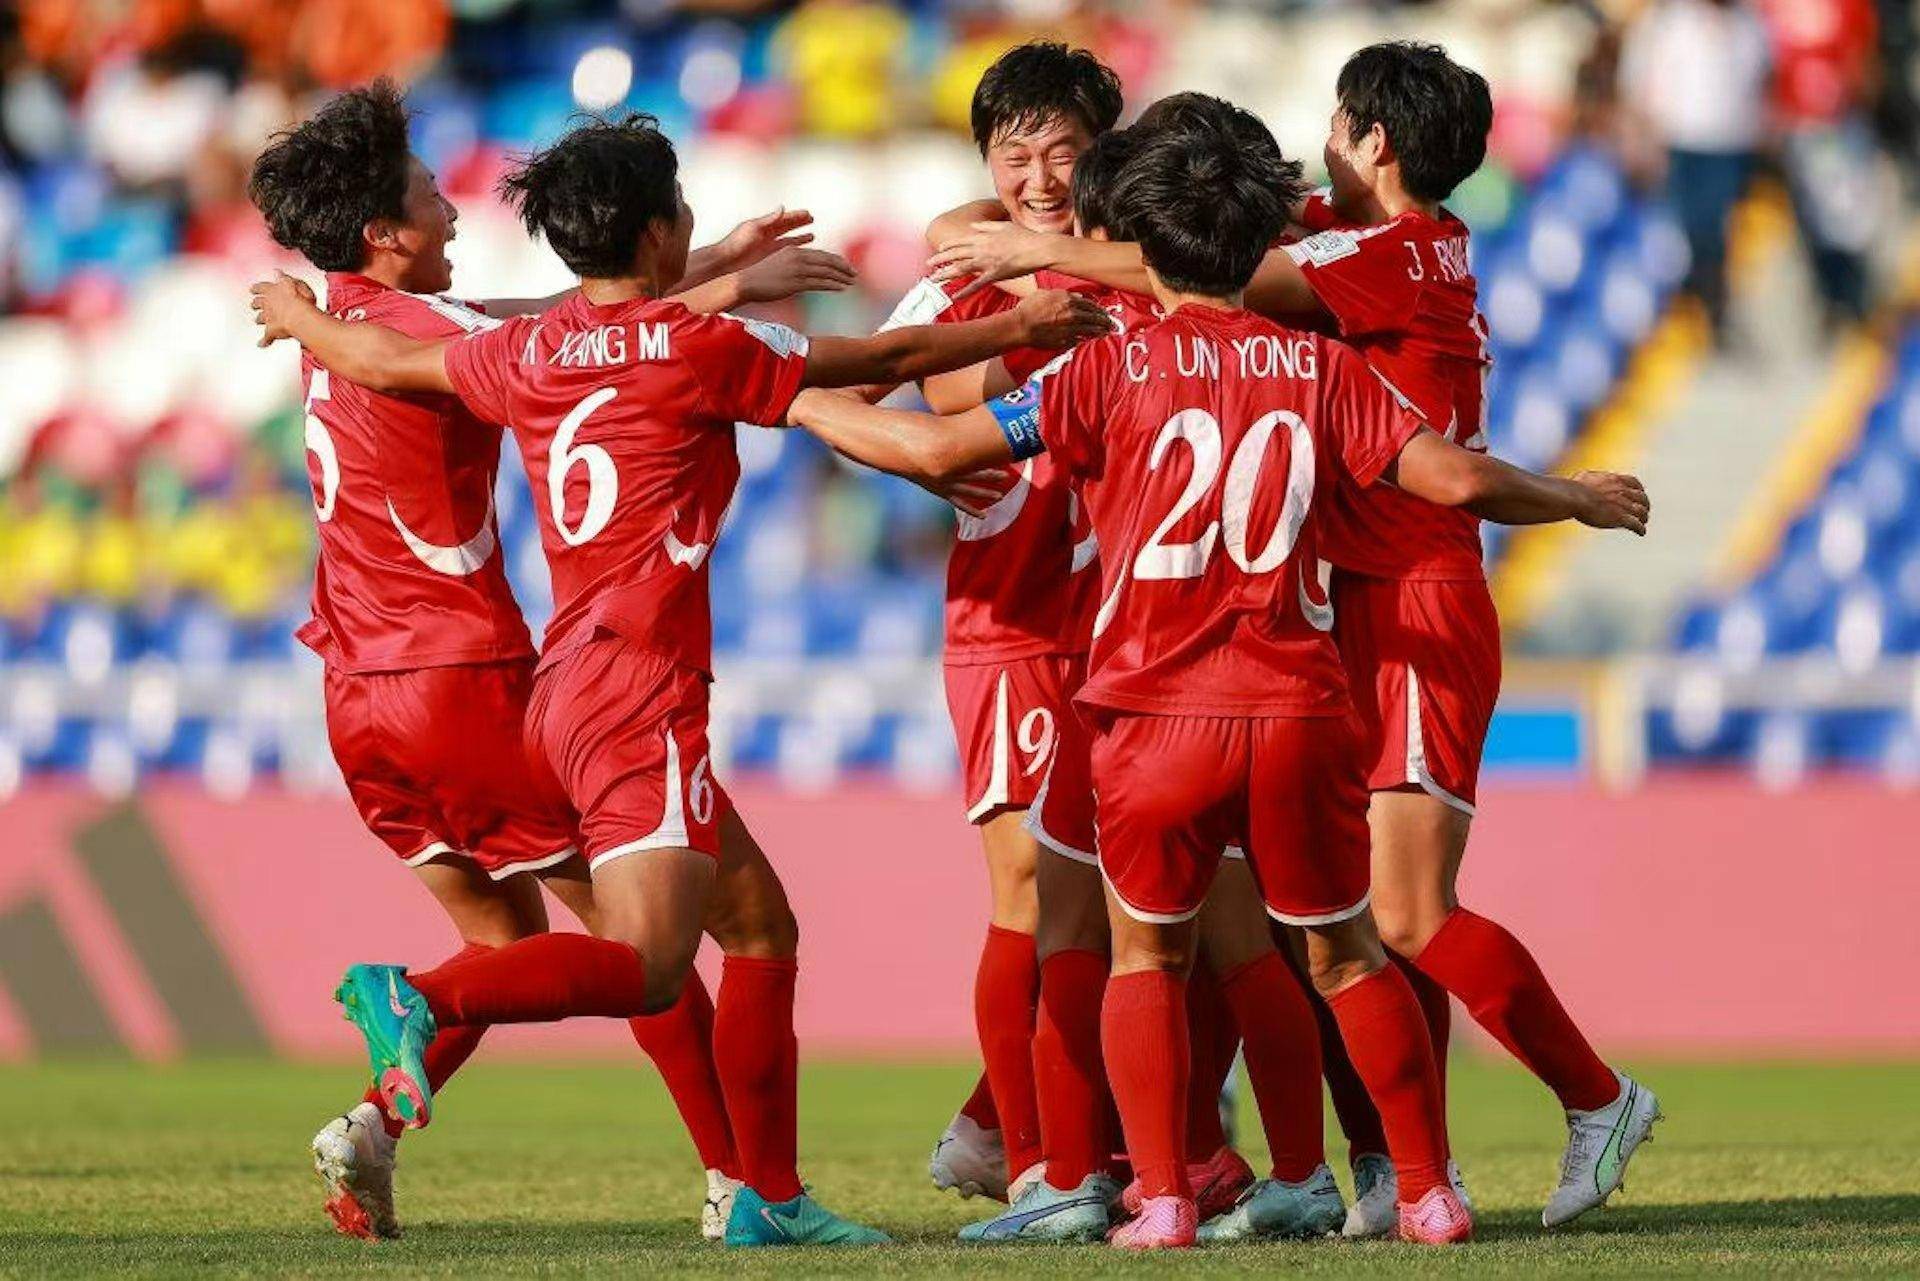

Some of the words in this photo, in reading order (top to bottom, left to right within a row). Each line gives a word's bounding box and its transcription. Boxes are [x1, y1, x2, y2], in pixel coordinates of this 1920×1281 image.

[638, 321, 670, 360] MI
[1173, 334, 1220, 380] UN
[1231, 334, 1317, 381] YONG
[304, 368, 341, 522] 5
[547, 386, 619, 546] 6
[1132, 407, 1316, 581] 20
[1017, 707, 1056, 778] 9
[689, 753, 715, 825] 6
